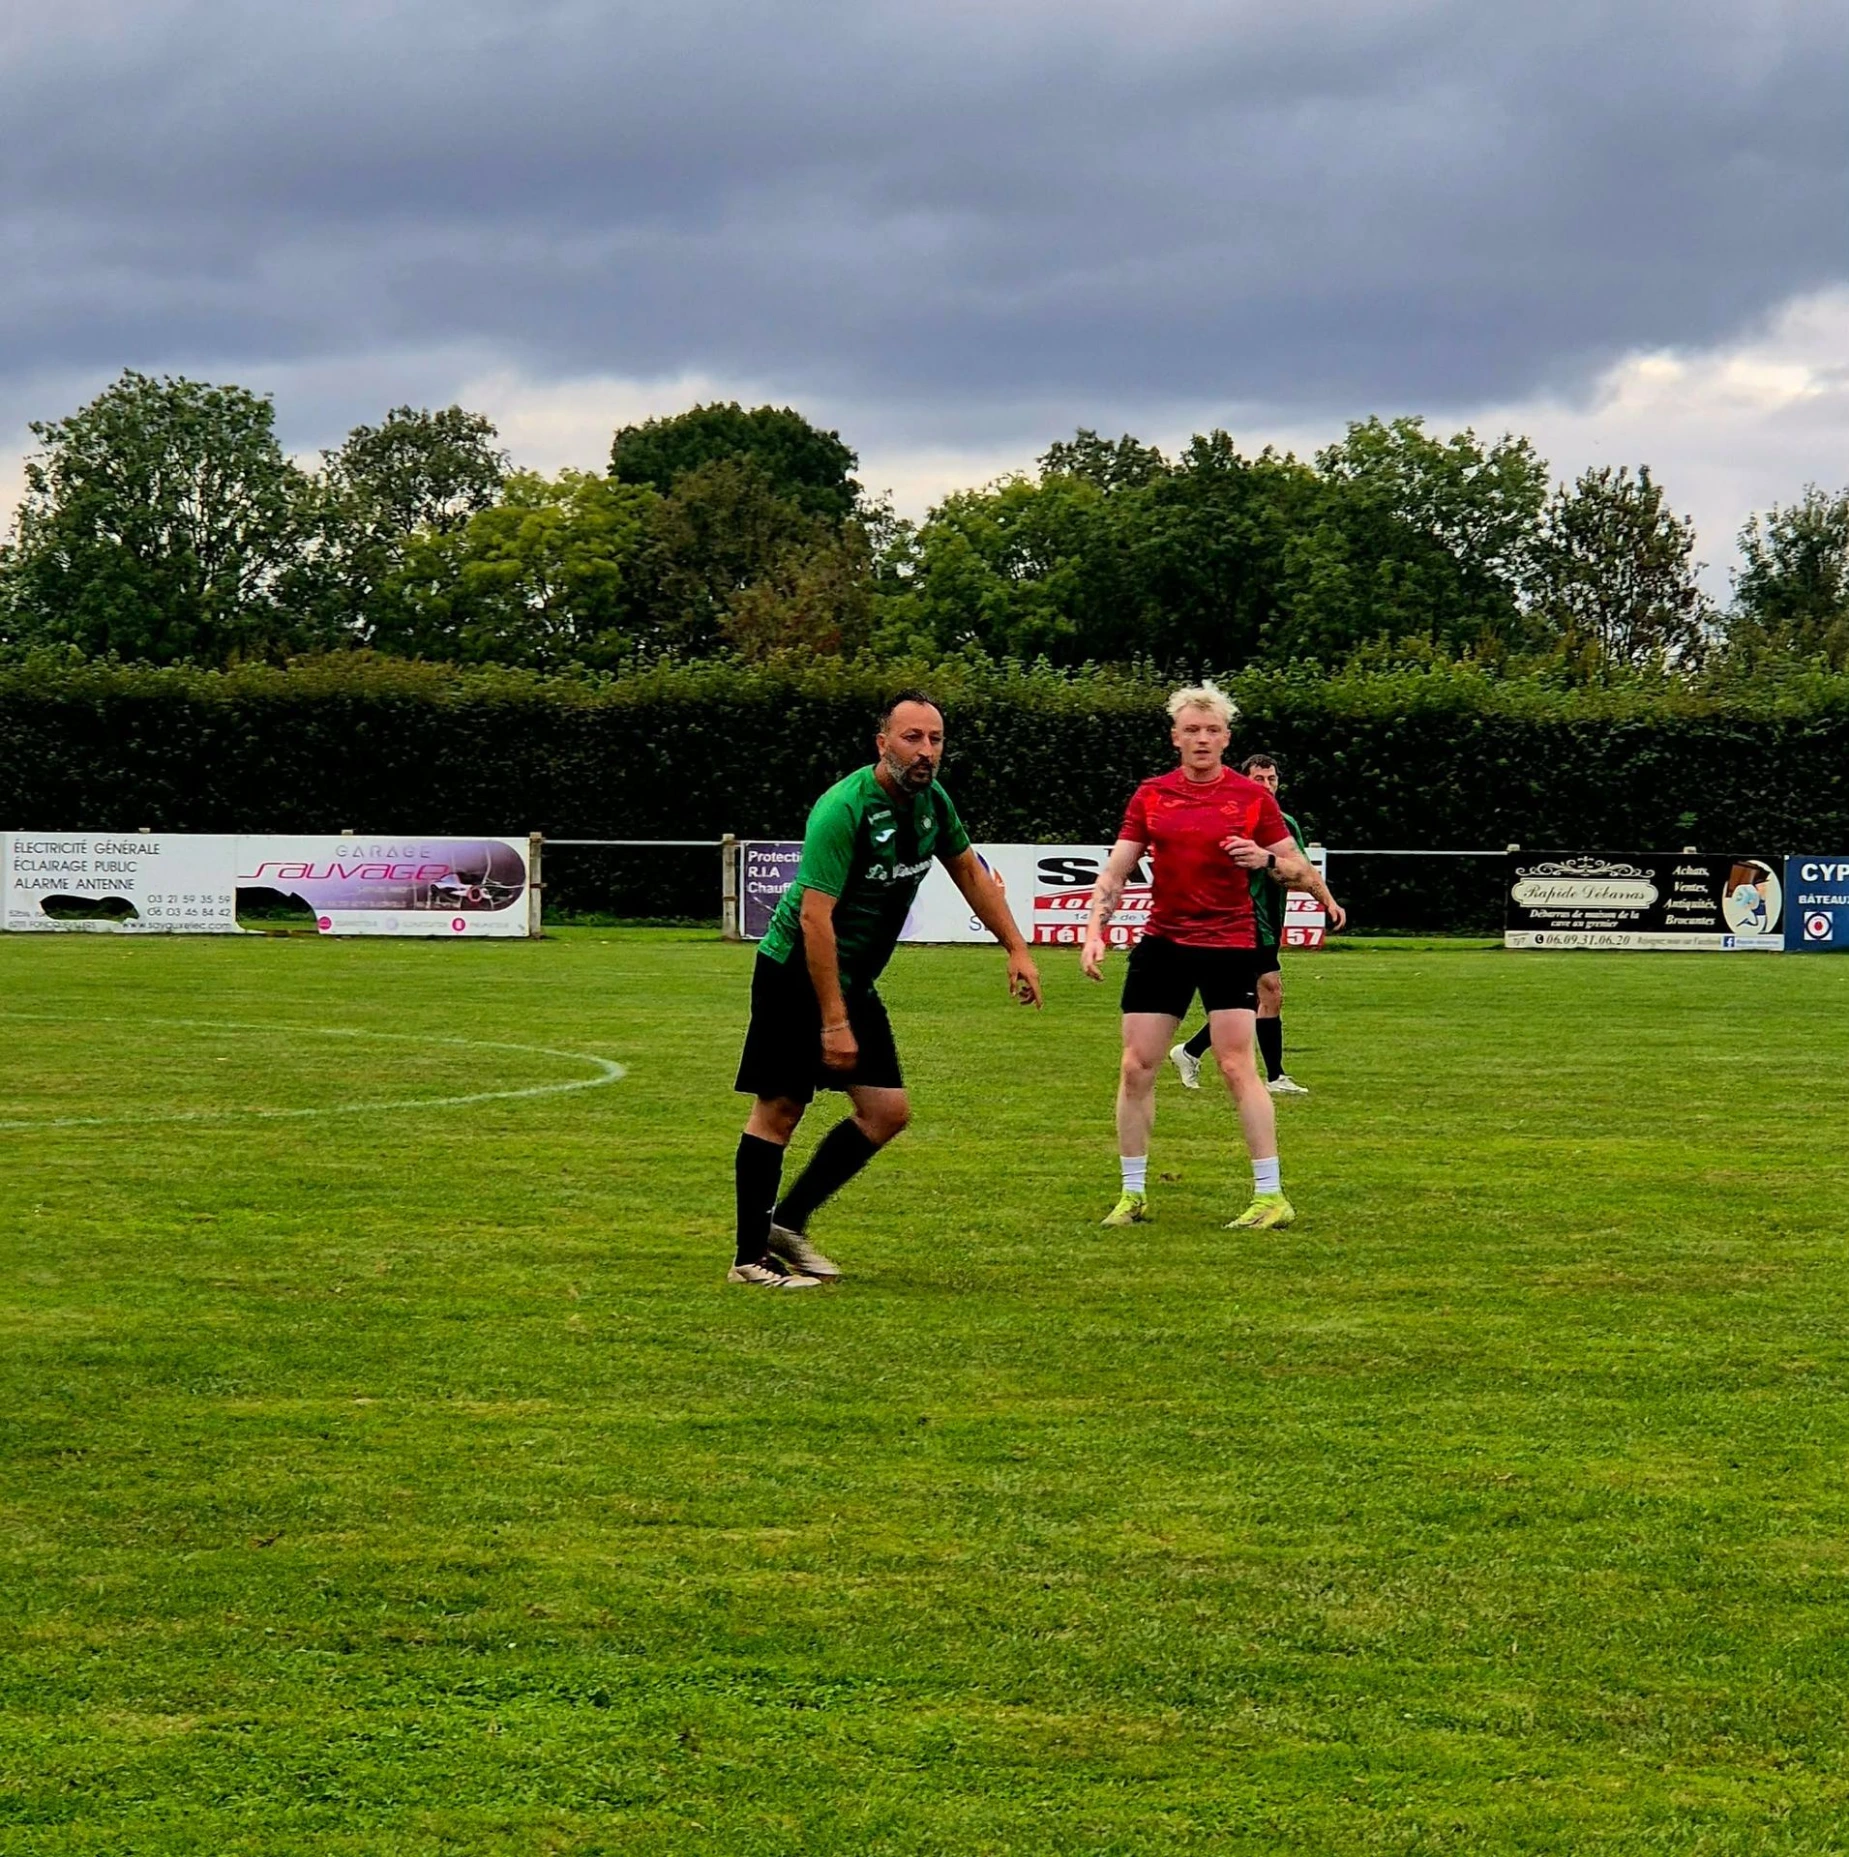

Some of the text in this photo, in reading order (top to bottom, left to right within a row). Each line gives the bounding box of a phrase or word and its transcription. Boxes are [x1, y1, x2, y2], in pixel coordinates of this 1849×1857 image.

[14, 839, 160, 855] ÉLECTRICITÉ GÉNÉRALE
[335, 844, 432, 859] GARAGE
[748, 851, 803, 863] Protecti
[14, 856, 137, 873] ÉCLAIRAGE PUBLIC
[748, 866, 780, 877] R.I.A
[14, 878, 135, 890] ALARME ANTENNE
[1674, 881, 1708, 893] Ventes,
[147, 894, 163, 903] 03
[167, 895, 178, 903] 21
[1524, 884, 1577, 903] Rapide
[147, 907, 163, 916] 06
[166, 907, 181, 916] 03
[1665, 915, 1715, 925] Brocantes
[1286, 928, 1323, 945] 57
